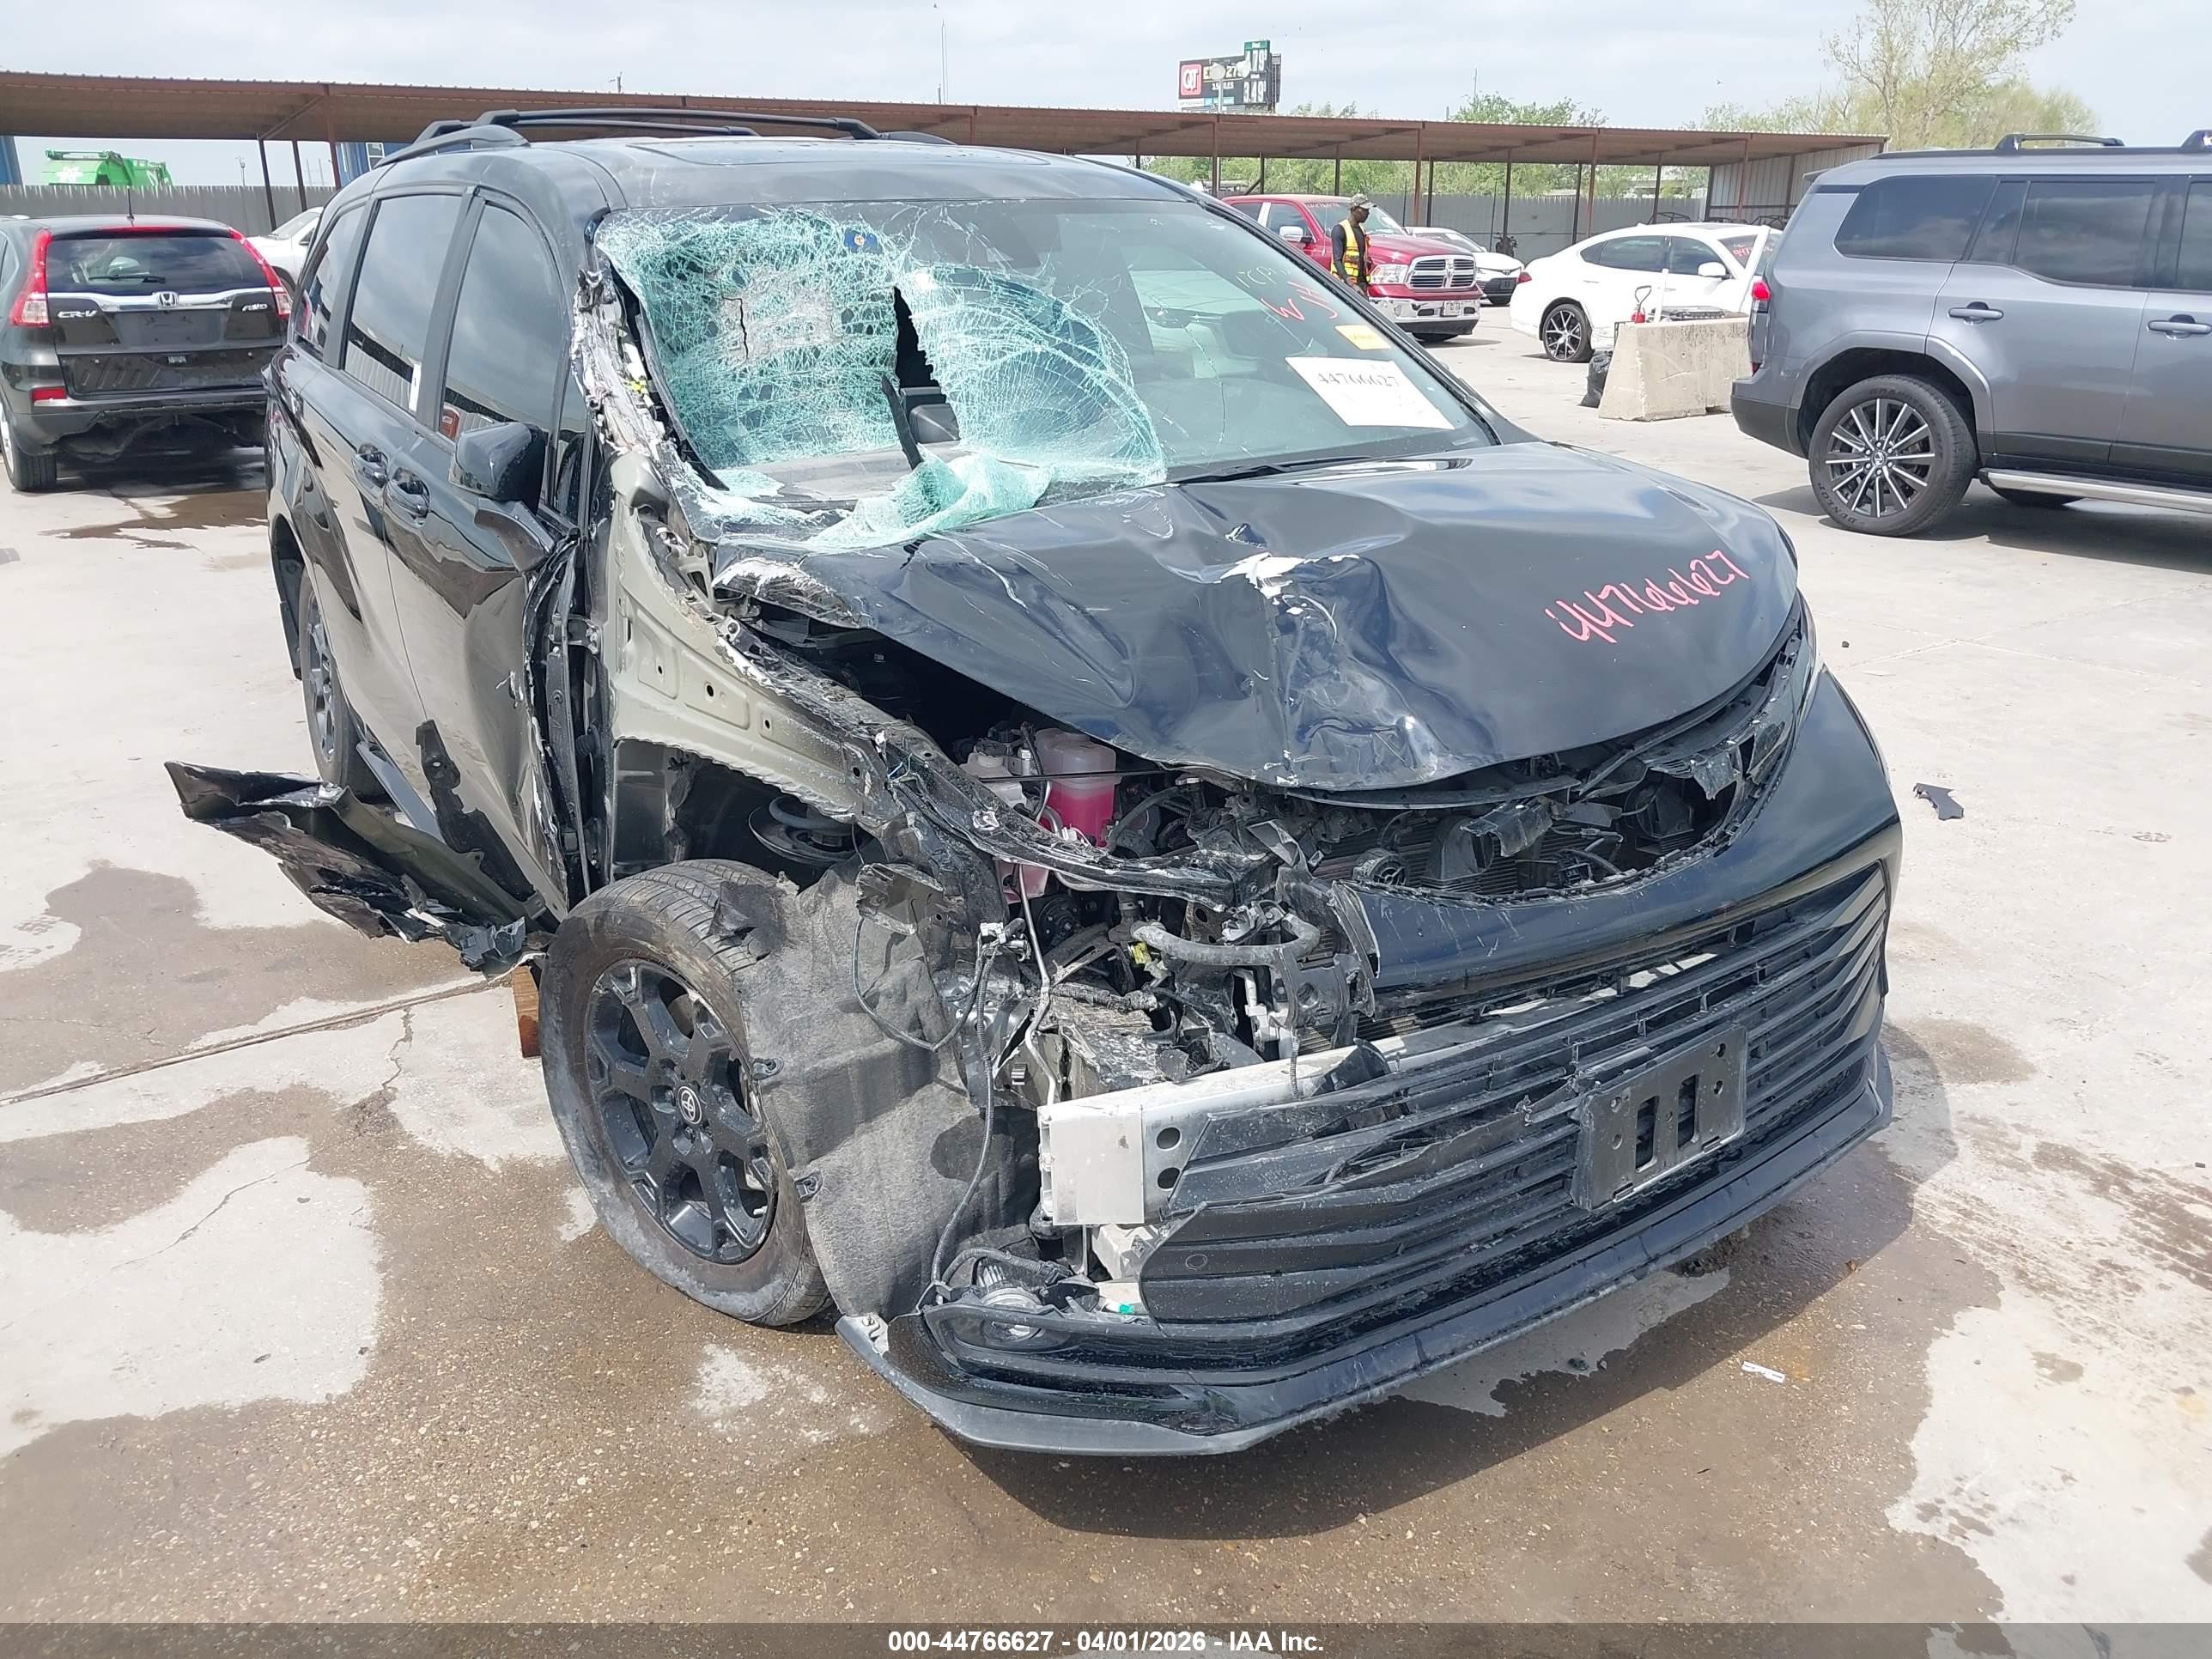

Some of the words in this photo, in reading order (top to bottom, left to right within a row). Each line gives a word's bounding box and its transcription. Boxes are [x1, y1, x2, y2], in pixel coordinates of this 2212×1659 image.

[1183, 68, 1200, 91] QT
[57, 309, 98, 319] CR-V
[241, 302, 268, 312] AWD
[1317, 372, 1400, 387] 44766627
[1545, 549, 1751, 644] 44766627
